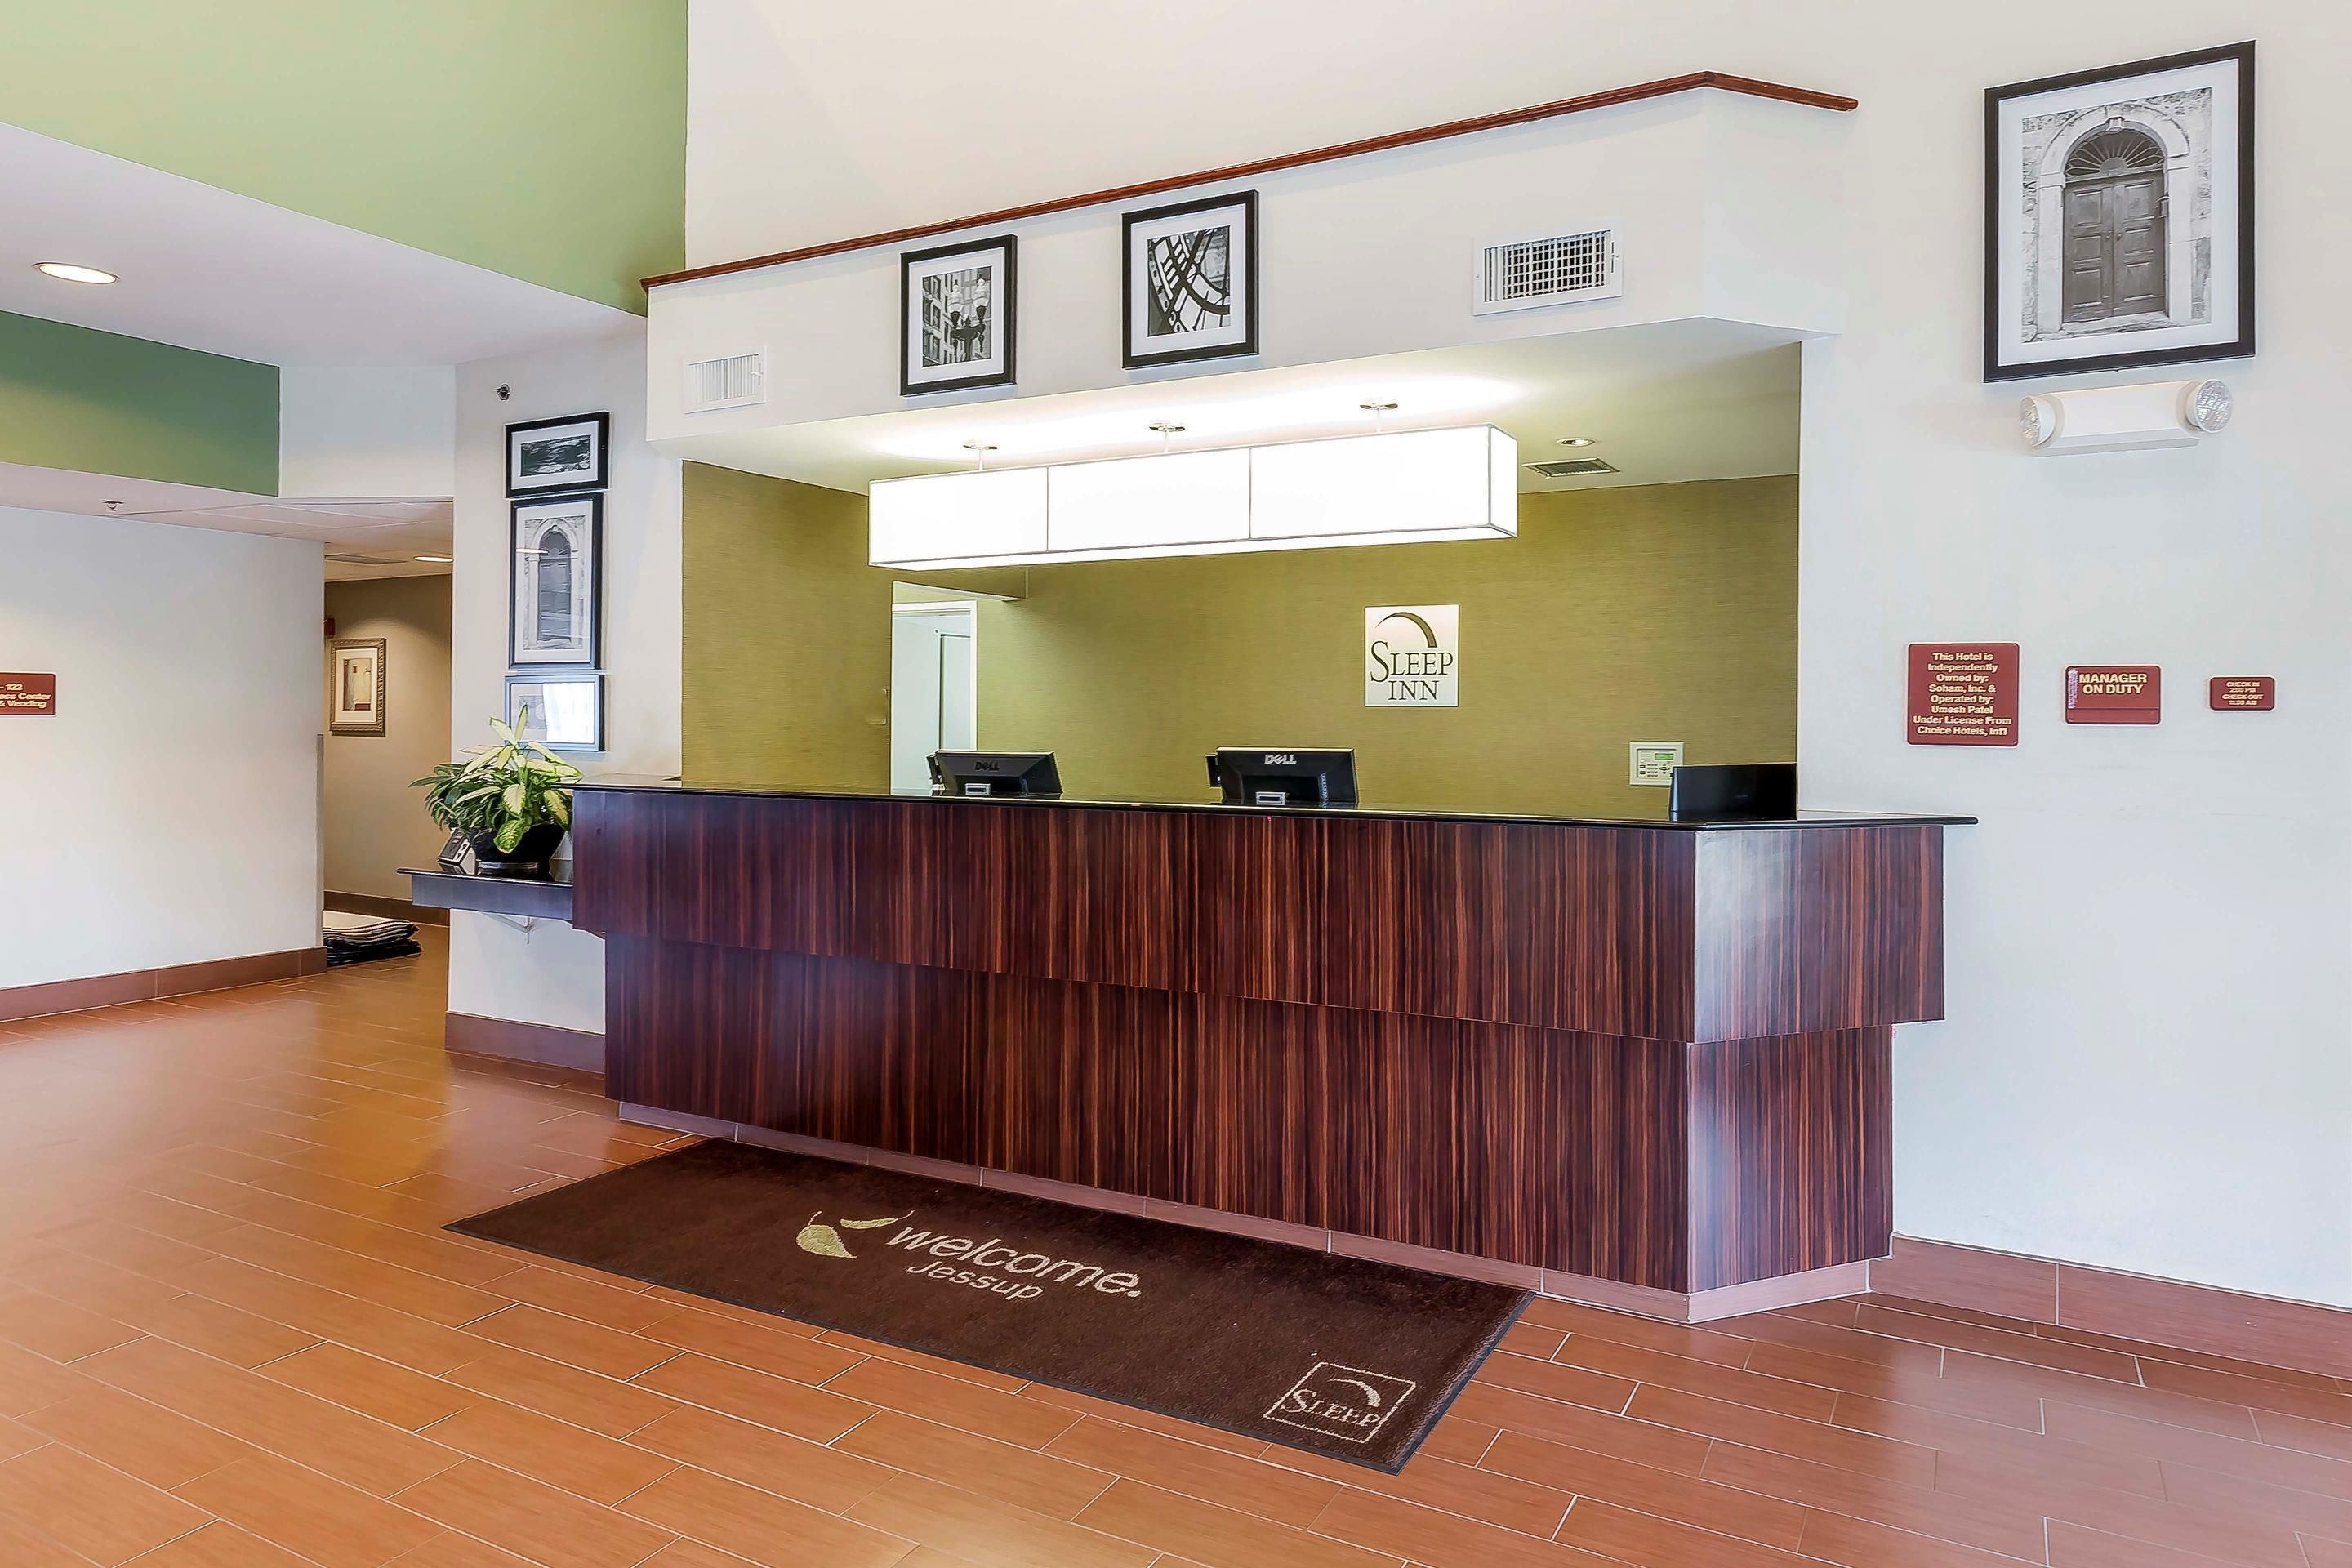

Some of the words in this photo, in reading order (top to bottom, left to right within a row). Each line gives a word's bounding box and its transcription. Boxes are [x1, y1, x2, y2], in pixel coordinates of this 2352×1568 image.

[1370, 640, 1454, 683] SLEEP
[1932, 653, 1953, 661] This
[1955, 653, 1982, 661] Hotel
[1984, 653, 1993, 661] is
[1927, 663, 1999, 673] Independently
[1936, 674, 1971, 682] Owned
[1973, 674, 1989, 684] by:
[2078, 673, 2148, 684] MANAGER
[1388, 680, 1440, 701] INN
[1928, 684, 1967, 693] Soham,
[1968, 684, 1986, 693] Inc.
[1988, 684, 1997, 693] &
[2082, 684, 2103, 694] ON
[2105, 684, 2144, 694] DUTY
[1930, 694, 1976, 704] Operated
[1978, 695, 1994, 705] by:
[1931, 705, 1966, 713] Umesh
[1967, 706, 1993, 714] Patel
[1913, 715, 1943, 724] Under
[1944, 715, 1984, 724] License
[1985, 716, 2012, 724] From
[1917, 725, 1951, 734] Choice
[1953, 726, 1988, 736] Hotels,
[1263, 754, 1297, 765] DELL
[974, 761, 1000, 771] DELL
[885, 1226, 1142, 1298] welcome.
[907, 1261, 1044, 1302] Jessup
[1280, 1388, 1381, 1427] SLEEP
